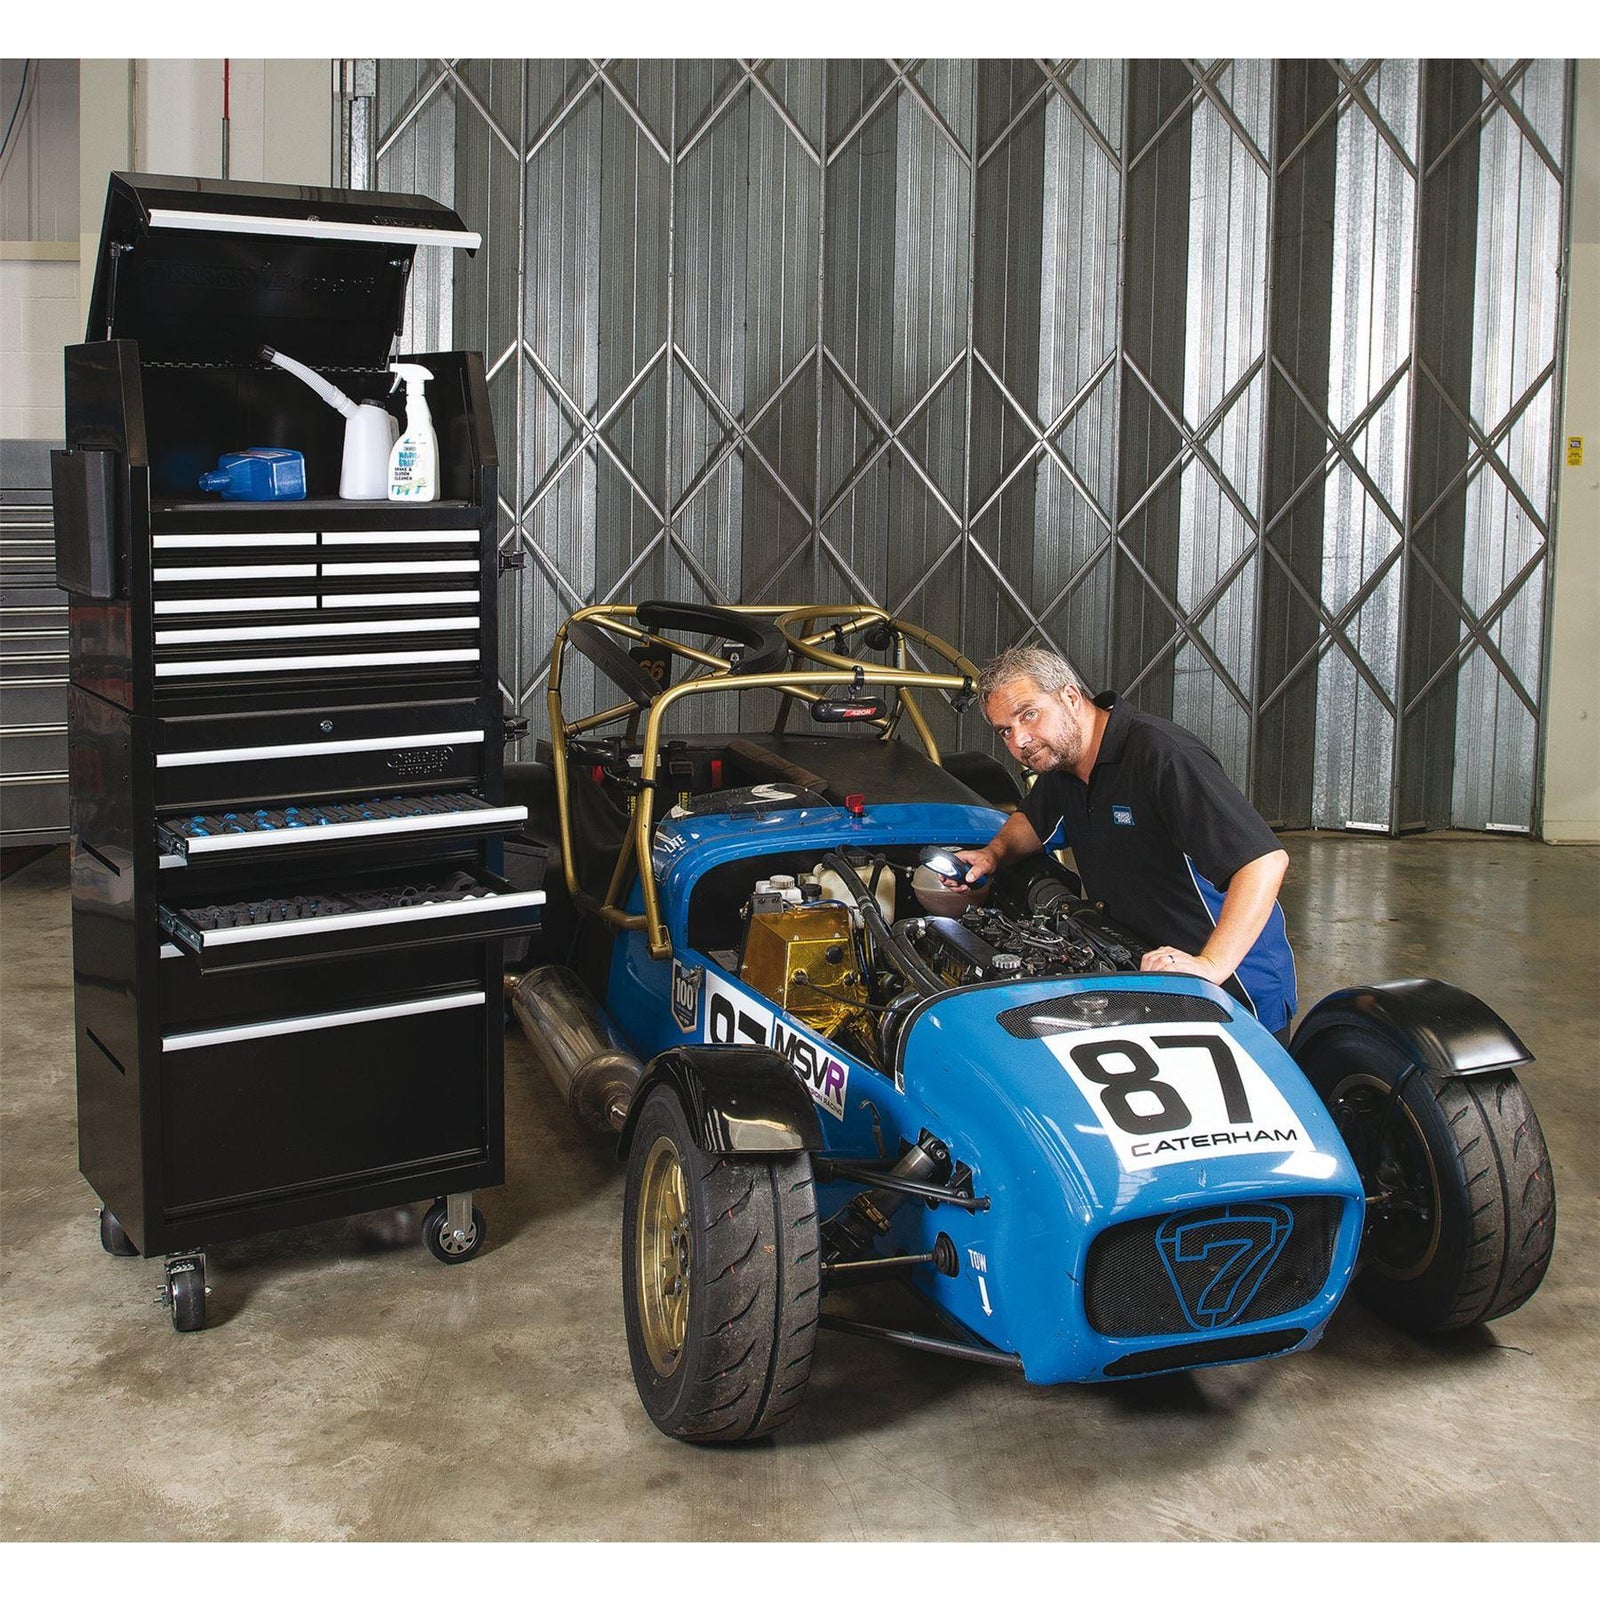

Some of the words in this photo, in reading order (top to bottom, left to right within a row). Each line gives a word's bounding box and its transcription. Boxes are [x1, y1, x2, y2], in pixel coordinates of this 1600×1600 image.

[676, 977, 694, 1011] 100
[775, 1023, 845, 1107] MSVR
[1069, 1034, 1253, 1136] 87
[1131, 1128, 1298, 1158] CATERHAM
[967, 1248, 987, 1273] TOW
